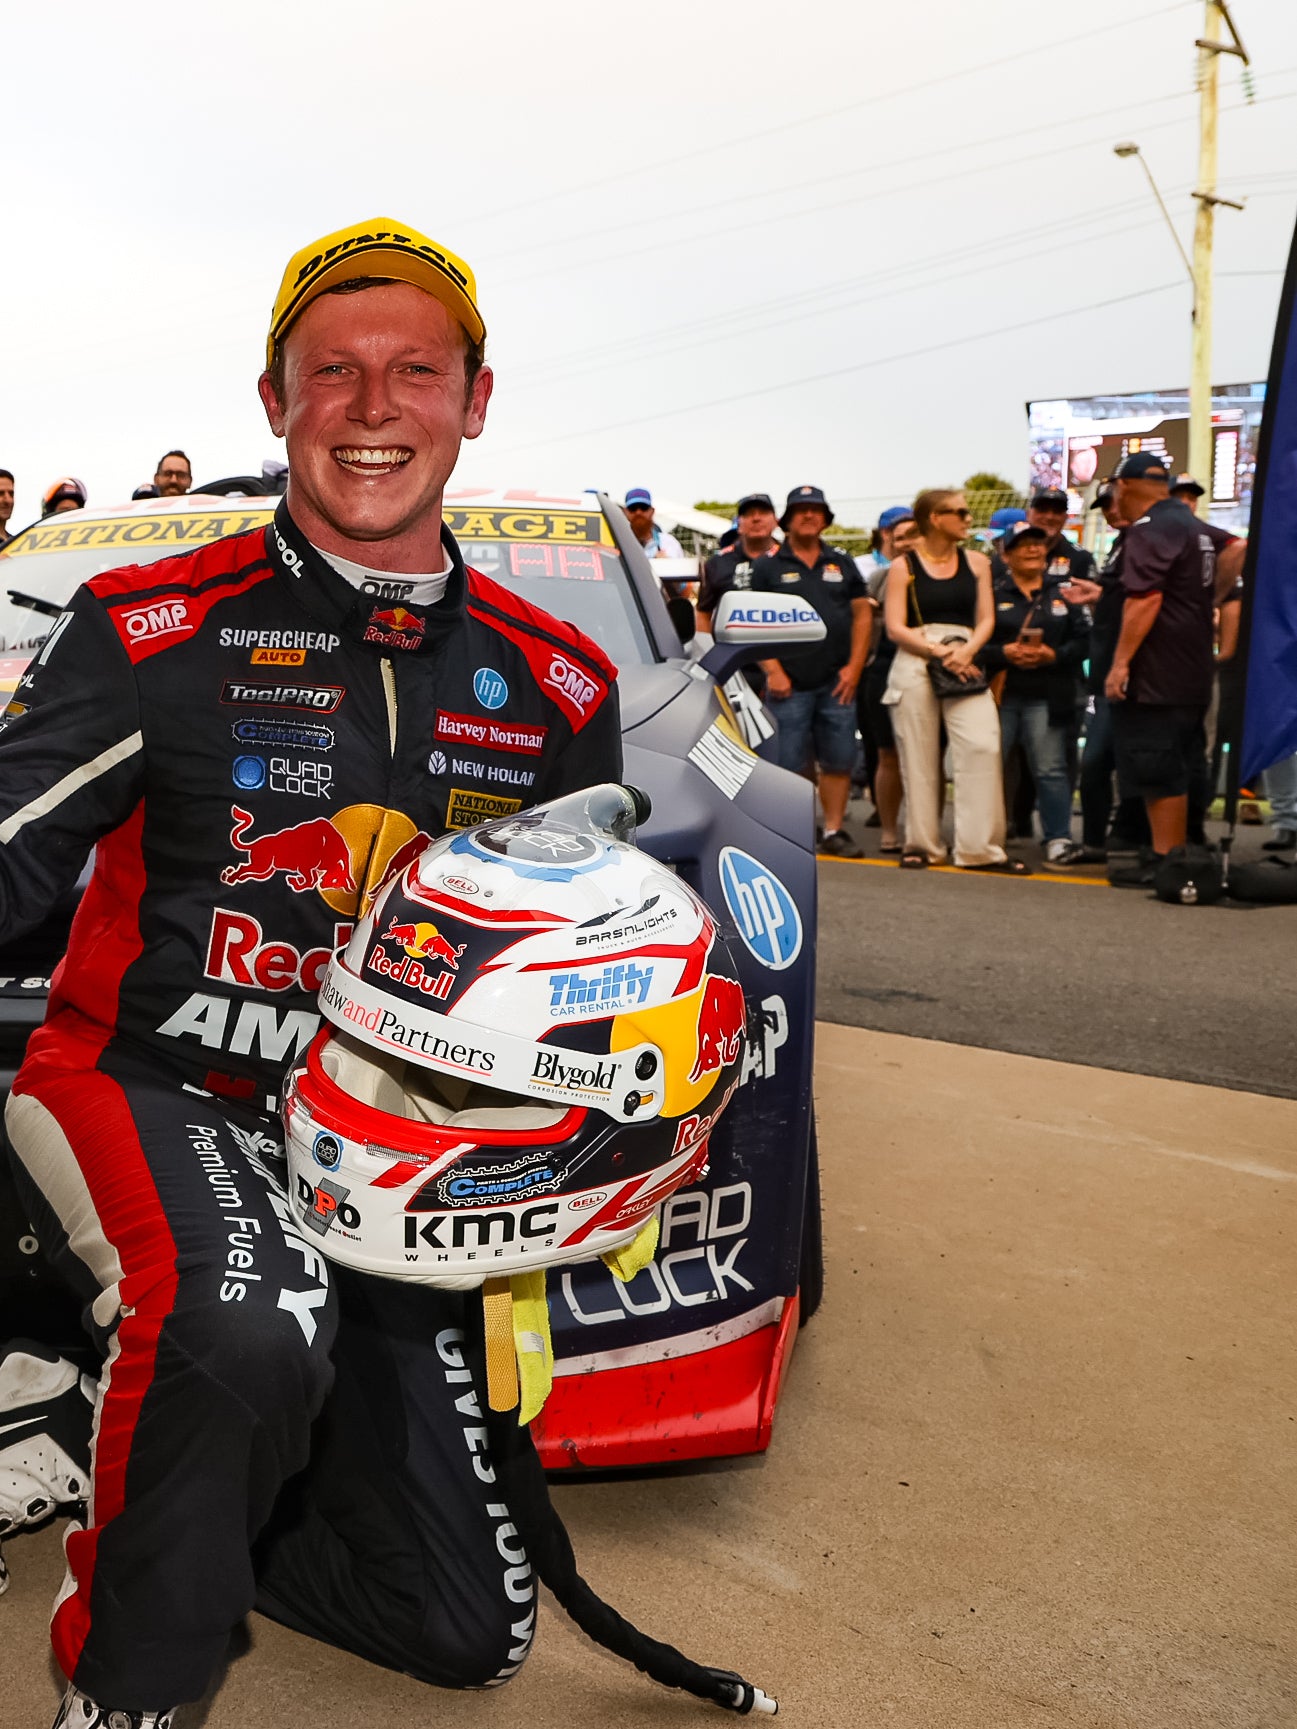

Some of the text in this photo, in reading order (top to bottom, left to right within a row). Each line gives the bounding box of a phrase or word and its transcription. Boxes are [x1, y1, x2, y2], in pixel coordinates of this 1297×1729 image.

[17, 516, 259, 550] NATIONAL
[360, 581, 415, 600] OMP
[125, 604, 188, 637] OMP
[219, 627, 341, 653] SUPERCHEAP
[363, 625, 423, 650] Red Bull
[257, 651, 302, 663] AUTO
[549, 660, 595, 706] OMP
[438, 715, 544, 749] Harvey Norman
[270, 757, 333, 781] QUAD
[452, 759, 485, 778] NEW
[270, 774, 332, 800] LOCK
[447, 877, 474, 892] BELL
[367, 943, 457, 1001] Red Bull
[549, 962, 654, 1006] Thrifty
[550, 999, 626, 1017] CAR RENTAL
[531, 1050, 618, 1090] Blygold
[527, 1084, 610, 1102] CORROSION PROTECTION
[449, 1168, 553, 1196] COMPLETE
[186, 1124, 262, 1303] Premium Fuels
[572, 1195, 603, 1208] BELL
[615, 1196, 654, 1219] OAKLEY
[404, 1238, 553, 1262] WHEELS
